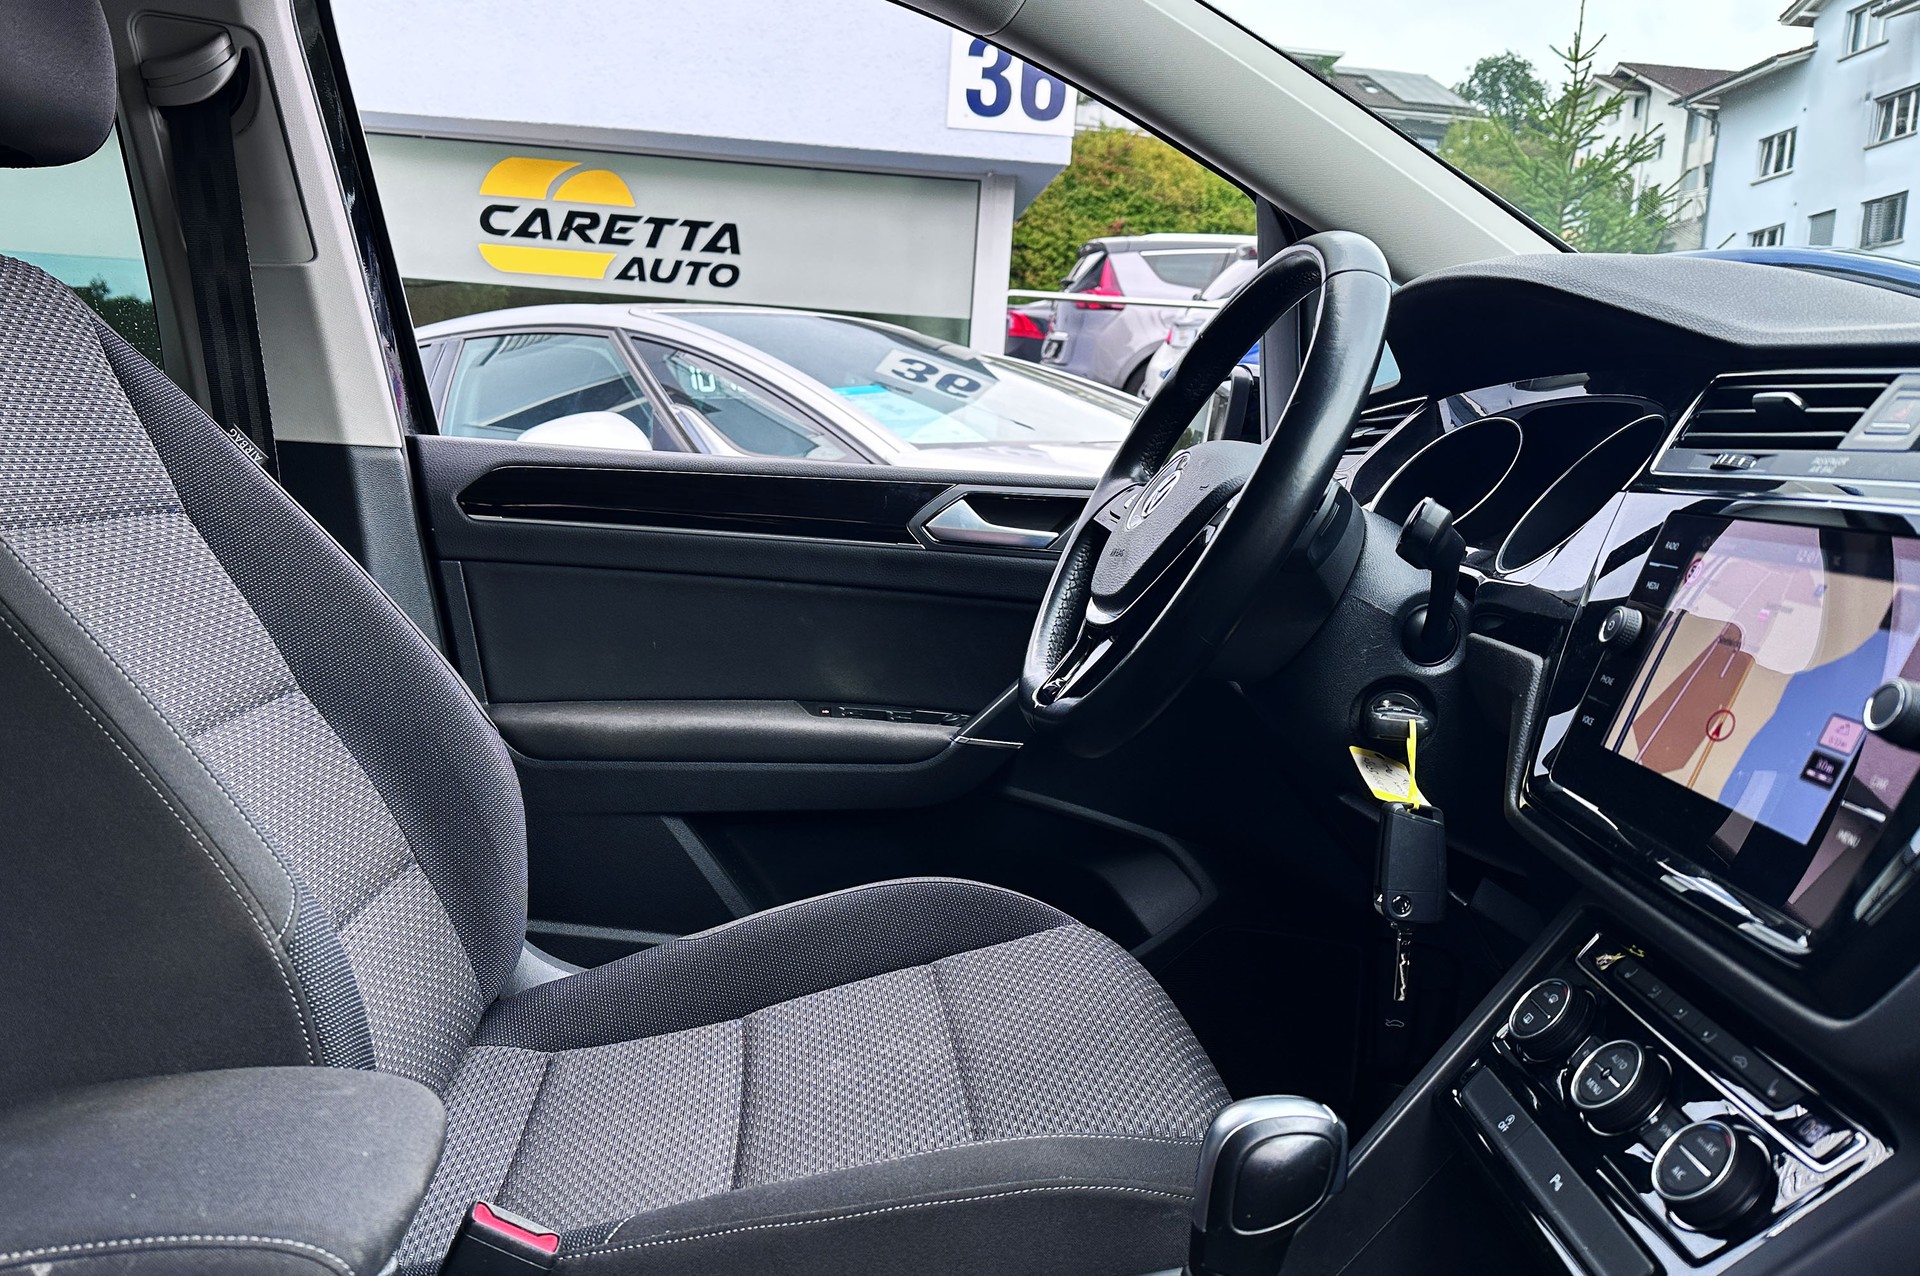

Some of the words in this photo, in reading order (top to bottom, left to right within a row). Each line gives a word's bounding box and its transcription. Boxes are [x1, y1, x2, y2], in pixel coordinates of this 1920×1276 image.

[479, 204, 741, 255] CARETTA
[614, 257, 740, 288] AUTO
[229, 428, 264, 461] AIRBAG
[1664, 541, 1680, 551] RADIO
[1646, 581, 1660, 590] MEDIA
[1836, 829, 1861, 849] MENU
[1611, 1054, 1628, 1070] AUTO
[1586, 1077, 1603, 1096] MENU
